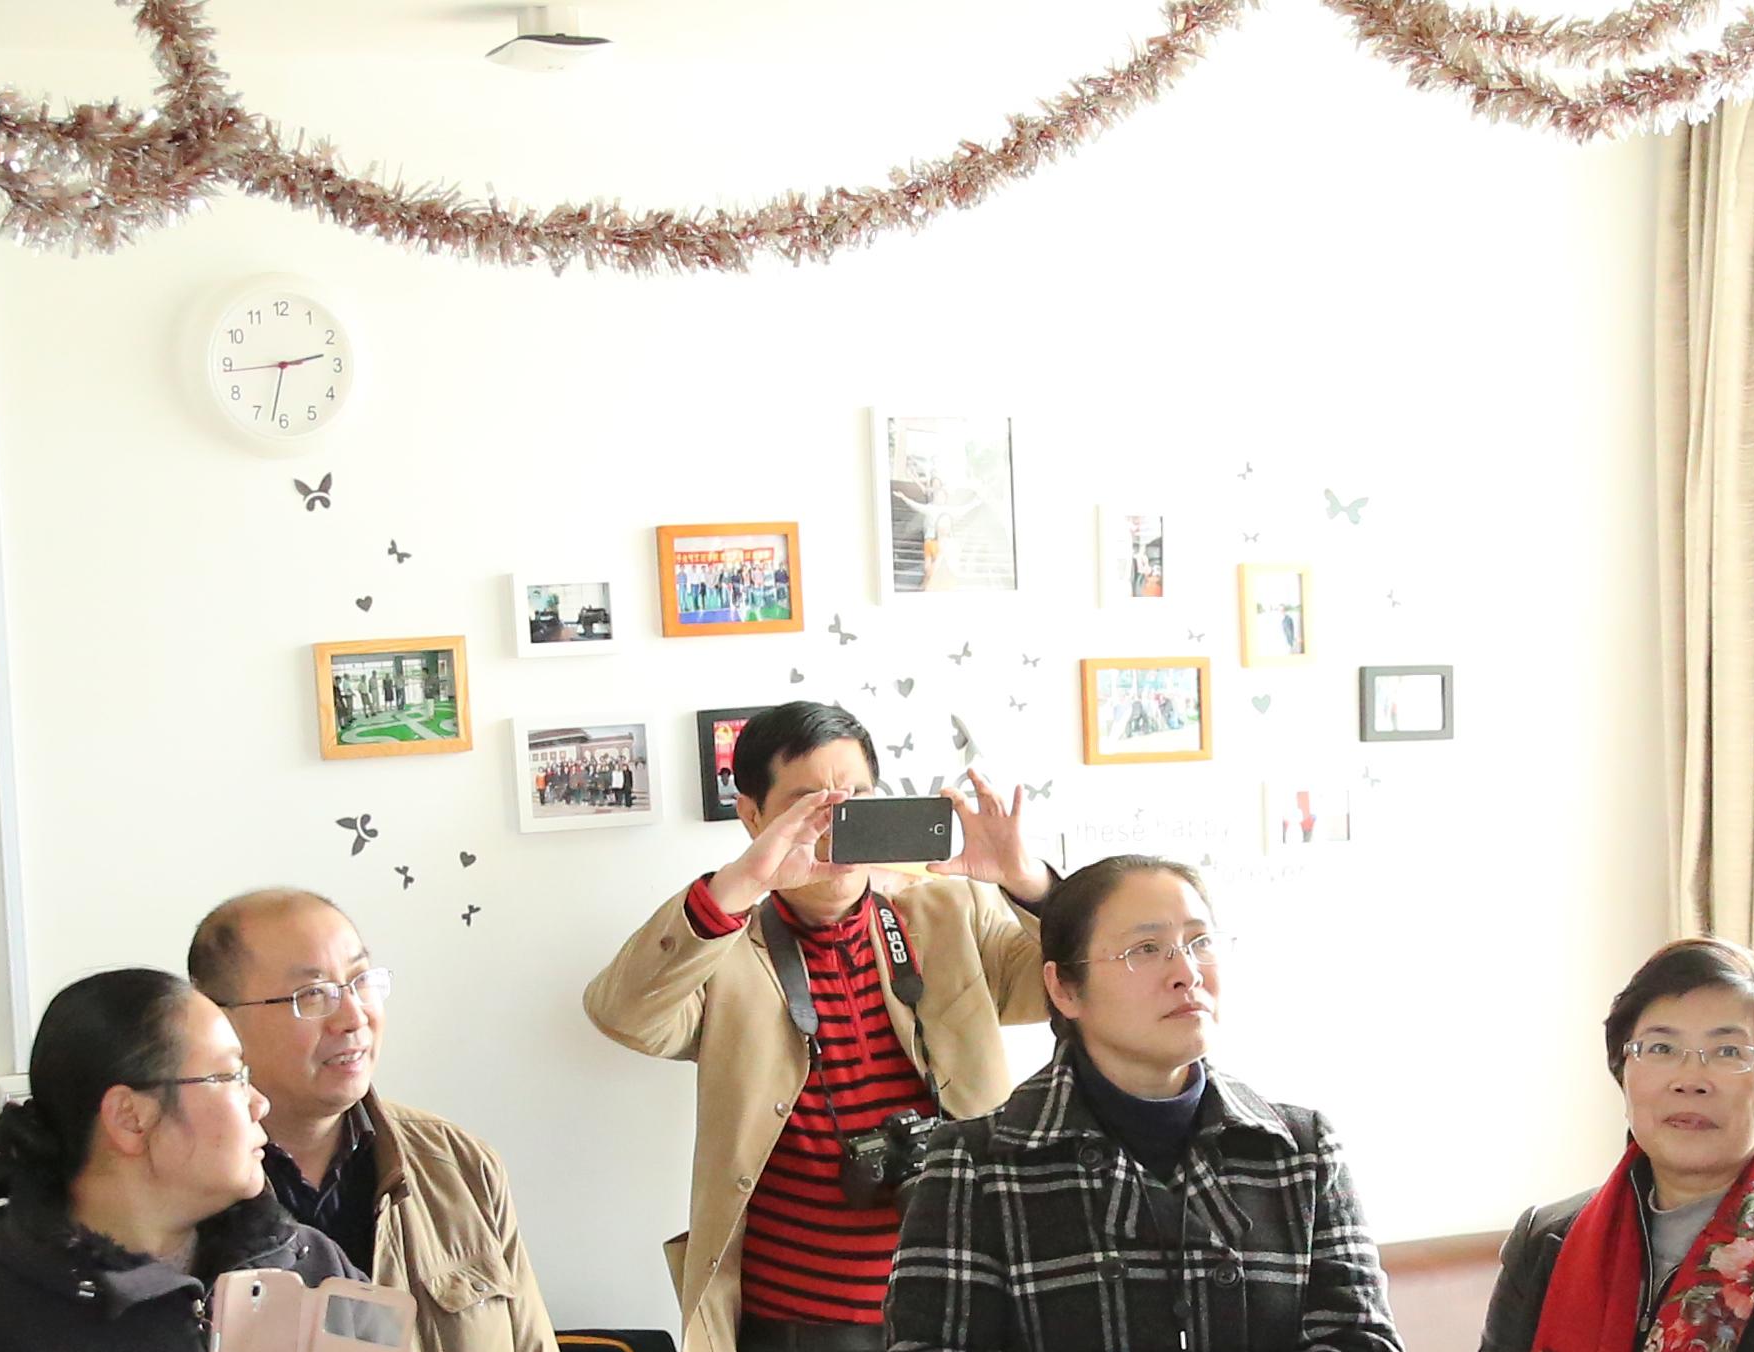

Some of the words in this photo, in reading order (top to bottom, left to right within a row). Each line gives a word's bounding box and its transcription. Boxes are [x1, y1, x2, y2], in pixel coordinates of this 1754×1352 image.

[272, 300, 290, 317] 12
[247, 309, 262, 325] 11
[304, 310, 313, 326] 1
[227, 328, 245, 345] 10
[324, 329, 336, 345] 2
[222, 356, 234, 372] 9
[332, 357, 343, 373] 3
[230, 384, 241, 401] 8
[325, 385, 336, 401] 4
[252, 405, 263, 421] 7
[306, 405, 318, 421] 5
[278, 413, 290, 430] 6
[879, 907, 899, 930] 70D
[886, 930, 908, 964] EOS
